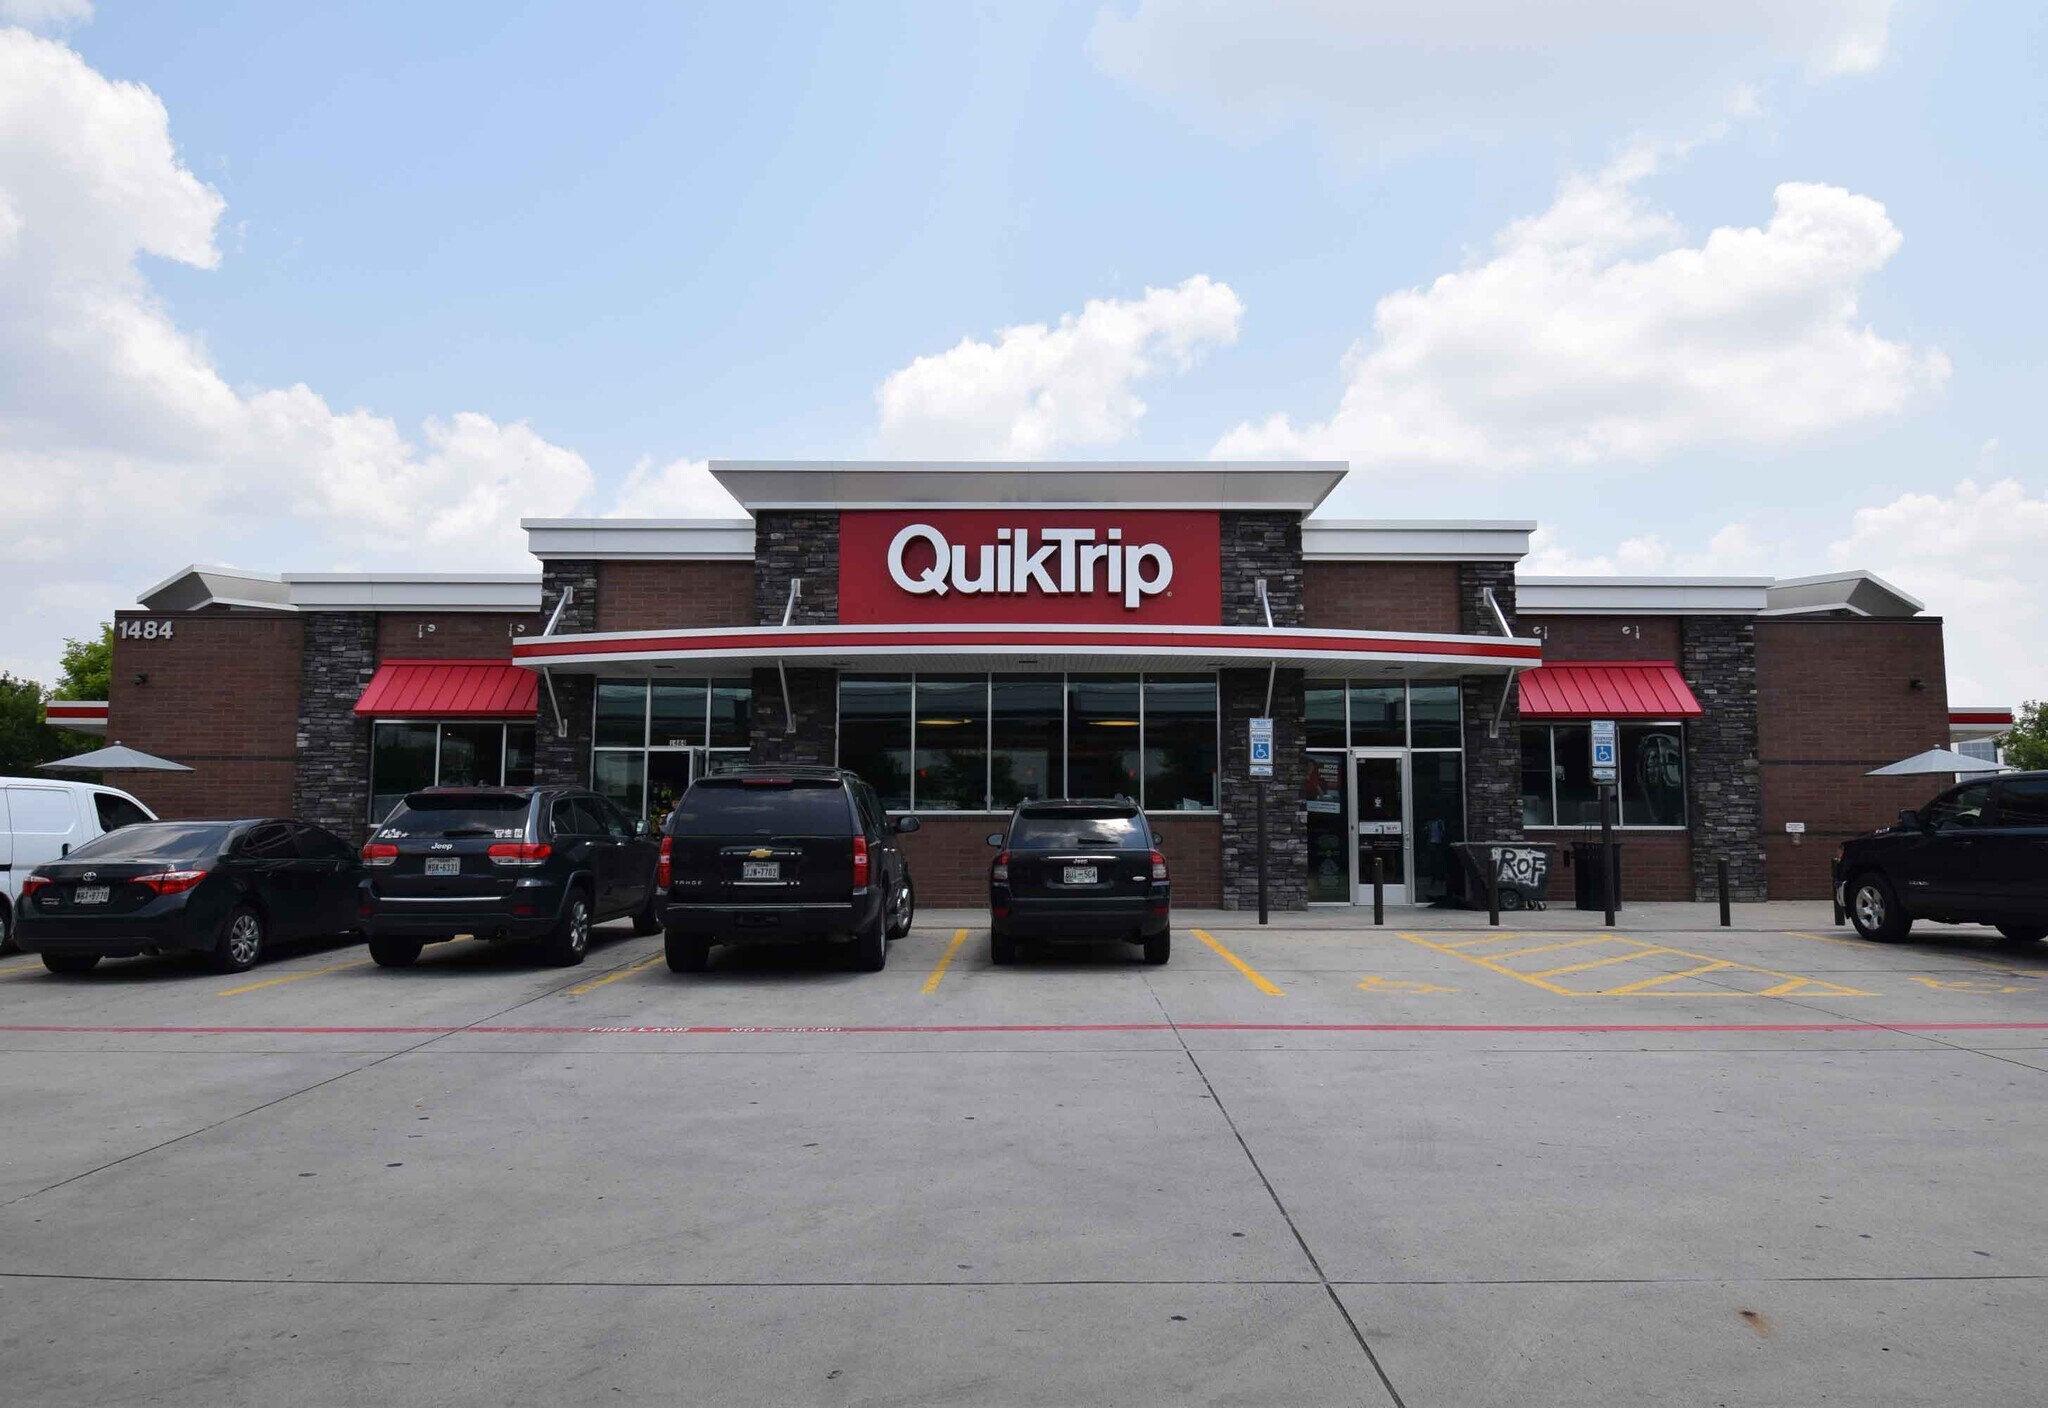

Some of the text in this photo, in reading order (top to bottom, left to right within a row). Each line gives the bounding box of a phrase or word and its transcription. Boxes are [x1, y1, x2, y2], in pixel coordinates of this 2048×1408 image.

[887, 523, 1174, 609] QuikTrip
[119, 620, 174, 640] 1484
[431, 842, 453, 850] Jeep
